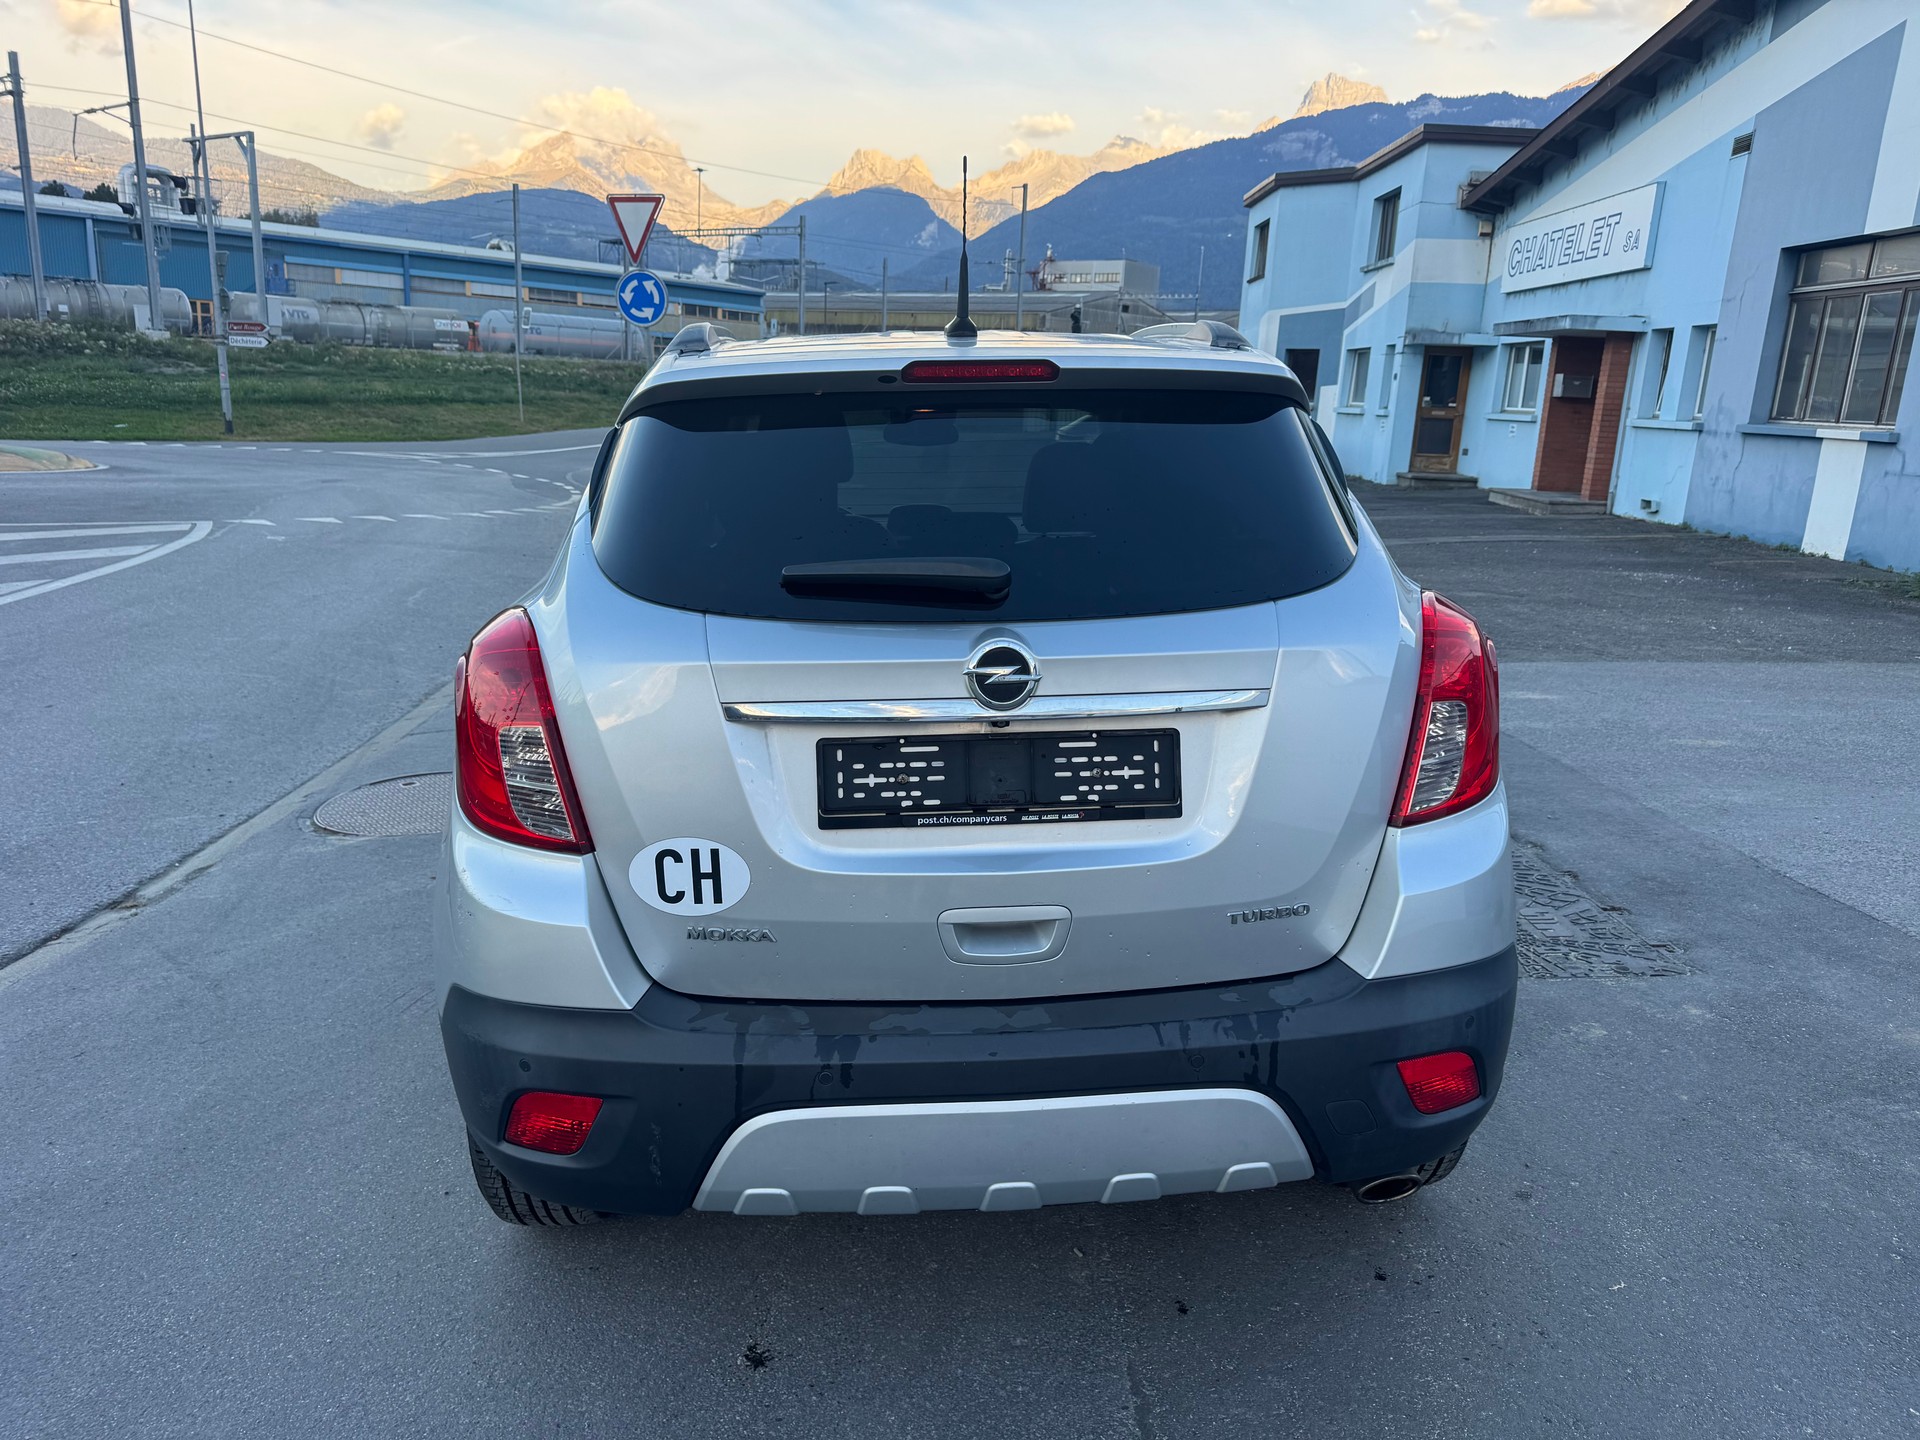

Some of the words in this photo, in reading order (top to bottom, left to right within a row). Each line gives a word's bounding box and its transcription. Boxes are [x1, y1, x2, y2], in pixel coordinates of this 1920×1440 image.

[1508, 212, 1622, 277] CHATELET
[1623, 229, 1641, 253] SA
[917, 815, 1008, 826] post.ch/companycars
[654, 848, 723, 905] CH
[1226, 902, 1311, 925] TURBO
[686, 926, 778, 943] MOKKA
